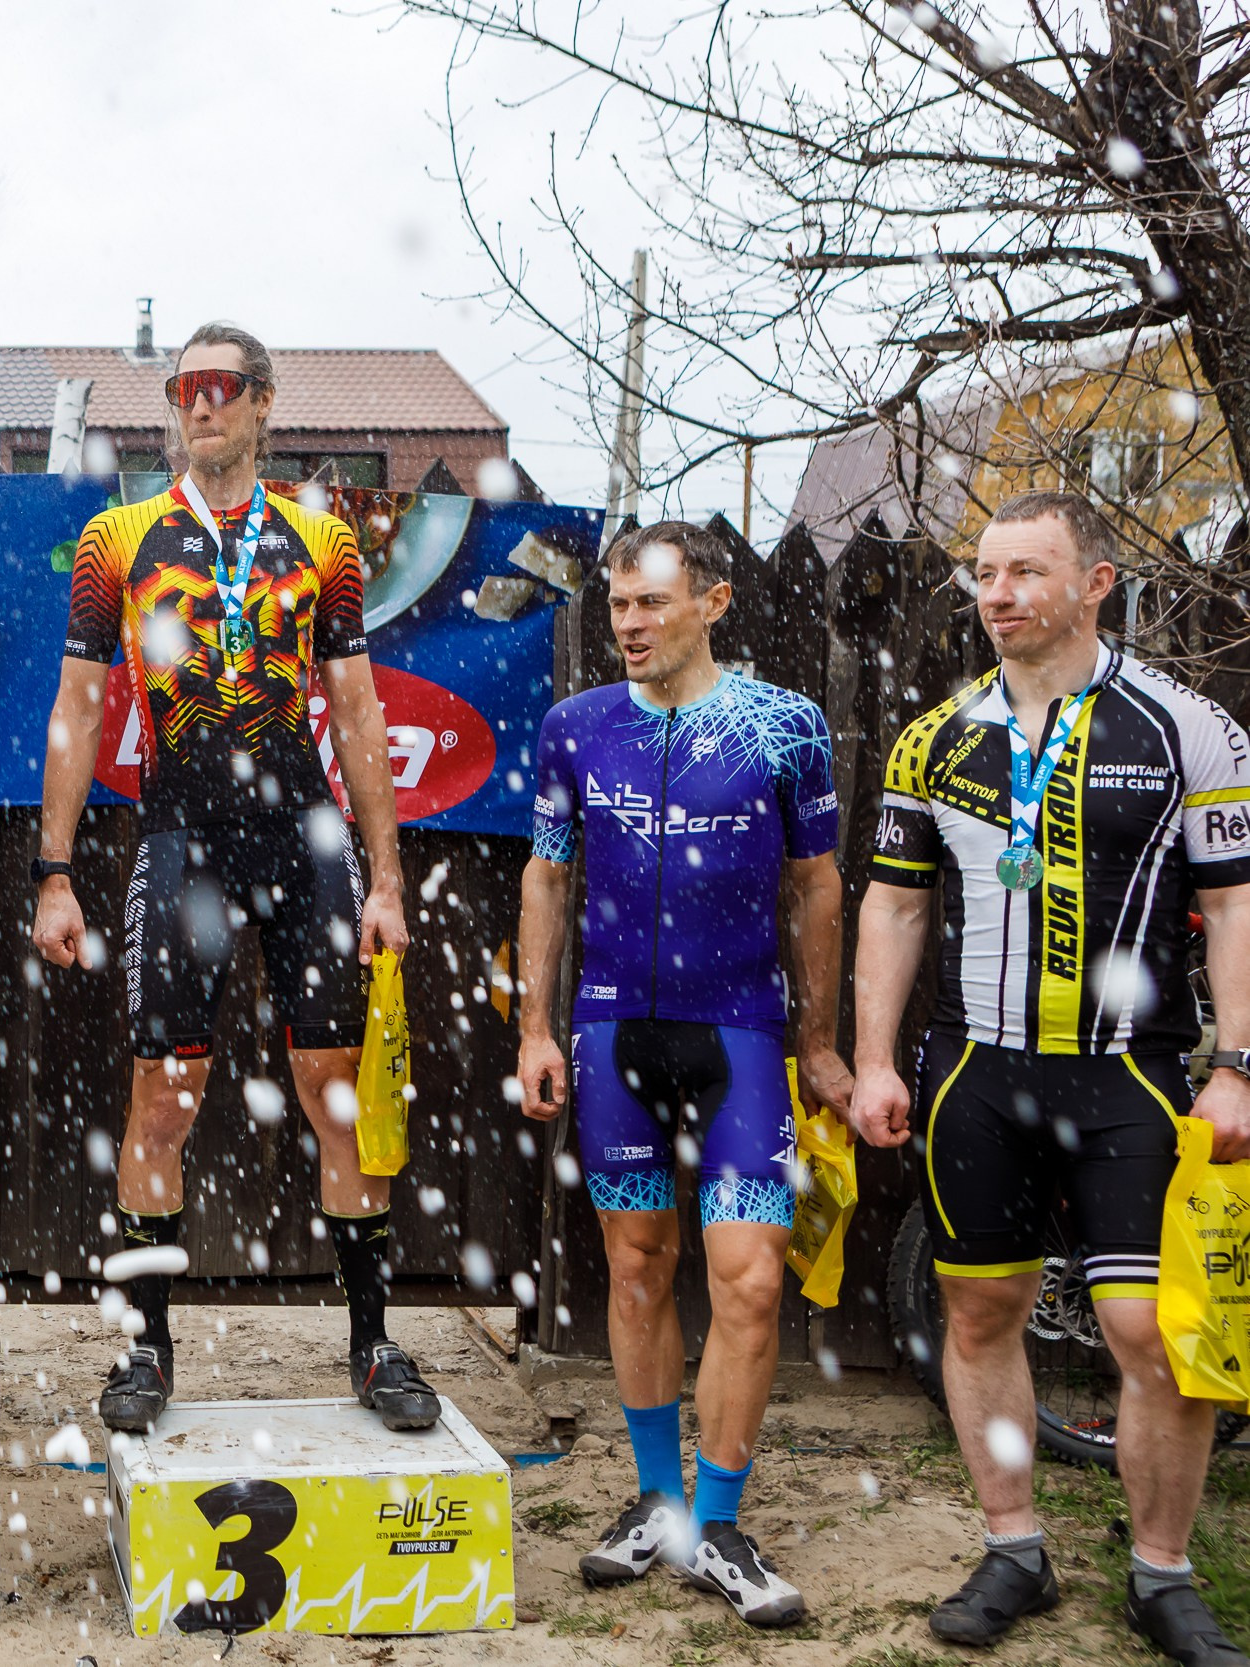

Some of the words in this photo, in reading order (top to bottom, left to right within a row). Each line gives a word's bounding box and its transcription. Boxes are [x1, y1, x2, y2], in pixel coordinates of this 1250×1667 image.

[230, 637, 241, 653] 3
[1020, 760, 1028, 789] ALTAY
[1031, 763, 1047, 792] ALTAY
[1090, 764, 1170, 779] MOUNTAIN
[949, 774, 1000, 802] МЕЧТОЙ
[1089, 777, 1124, 789] BIKE
[1126, 779, 1165, 791] CLUB
[816, 791, 837, 807] ТВО
[1047, 735, 1082, 869] TRAVEL
[1048, 883, 1079, 982] REVA
[592, 986, 618, 994] ТВОЯ
[379, 1496, 468, 1528] PULSE
[376, 1532, 389, 1540] СЕТЬ
[396, 1541, 451, 1553] TVOYPULSE.RU
[173, 1480, 298, 1634] 3
